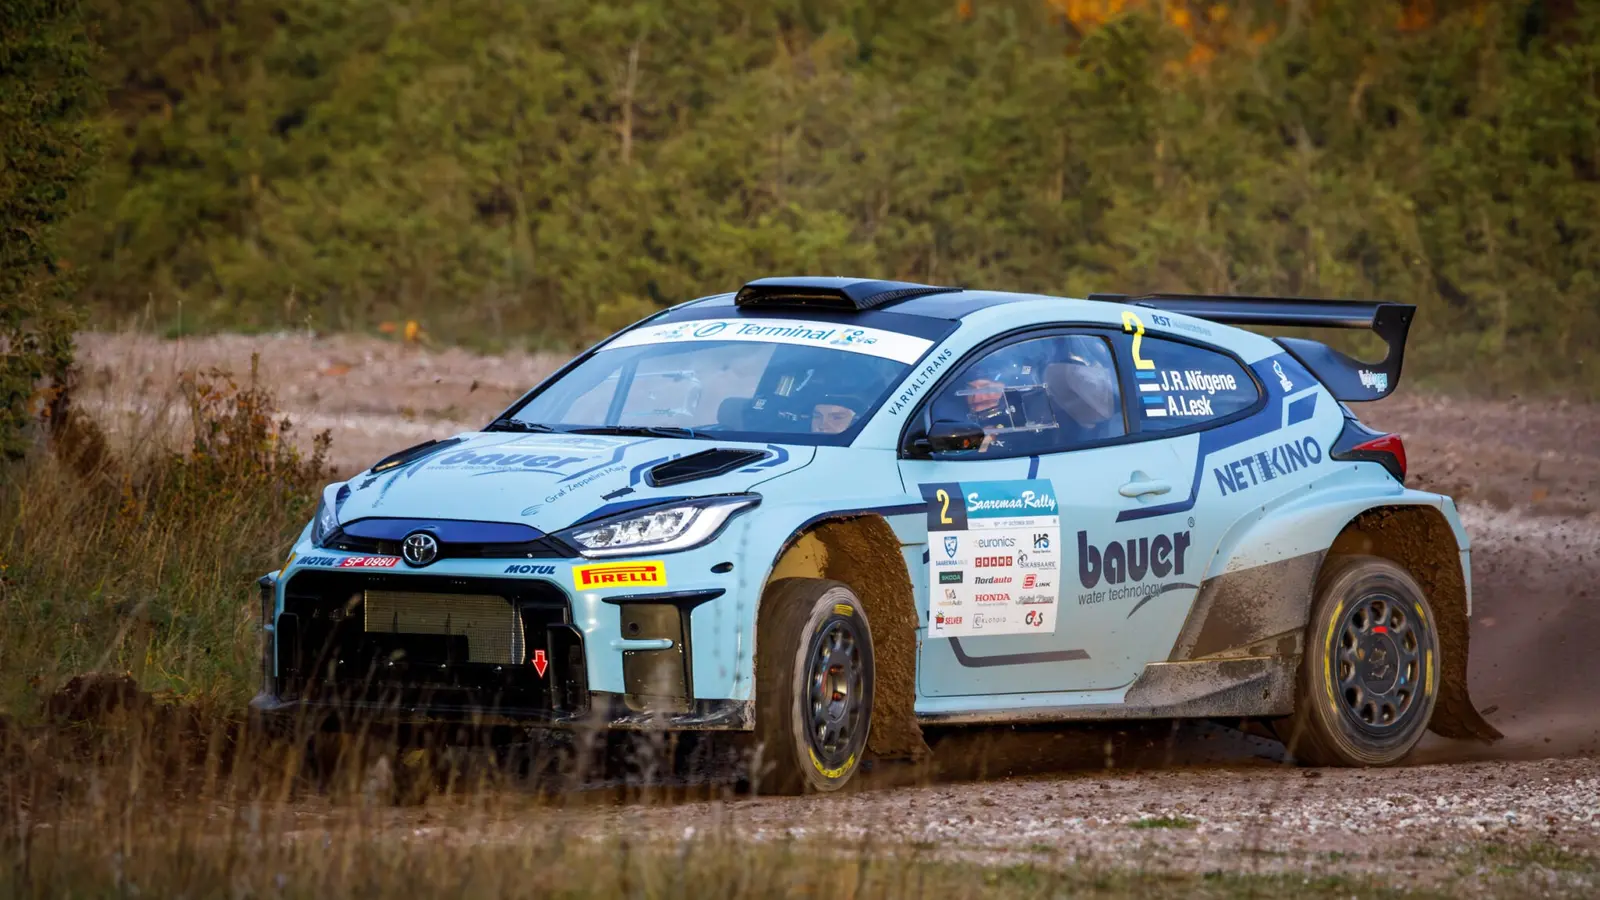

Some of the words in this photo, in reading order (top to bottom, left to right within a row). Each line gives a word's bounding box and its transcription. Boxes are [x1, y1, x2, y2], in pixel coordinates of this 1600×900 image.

[1151, 314, 1171, 328] RST
[736, 322, 837, 341] Terminal
[1121, 311, 1156, 370] 2
[1161, 370, 1238, 395] J.R.Nõgene
[1167, 395, 1214, 416] A.Lesk
[440, 450, 588, 469] bauer
[936, 489, 953, 524] 2
[967, 492, 1022, 512] Saaremaa
[1021, 490, 1057, 512] Rally
[978, 535, 1016, 548] euronics
[296, 556, 337, 567] MOTUL
[344, 557, 365, 567] SP
[364, 557, 396, 568] 0980
[504, 564, 557, 575] MOTUL
[1077, 530, 1191, 590] bauer
[582, 566, 658, 586] PIRELLI
[975, 593, 1011, 602] HONDA
[1078, 591, 1106, 605] water
[1108, 582, 1163, 602] technology
[945, 616, 963, 625] SELVER
